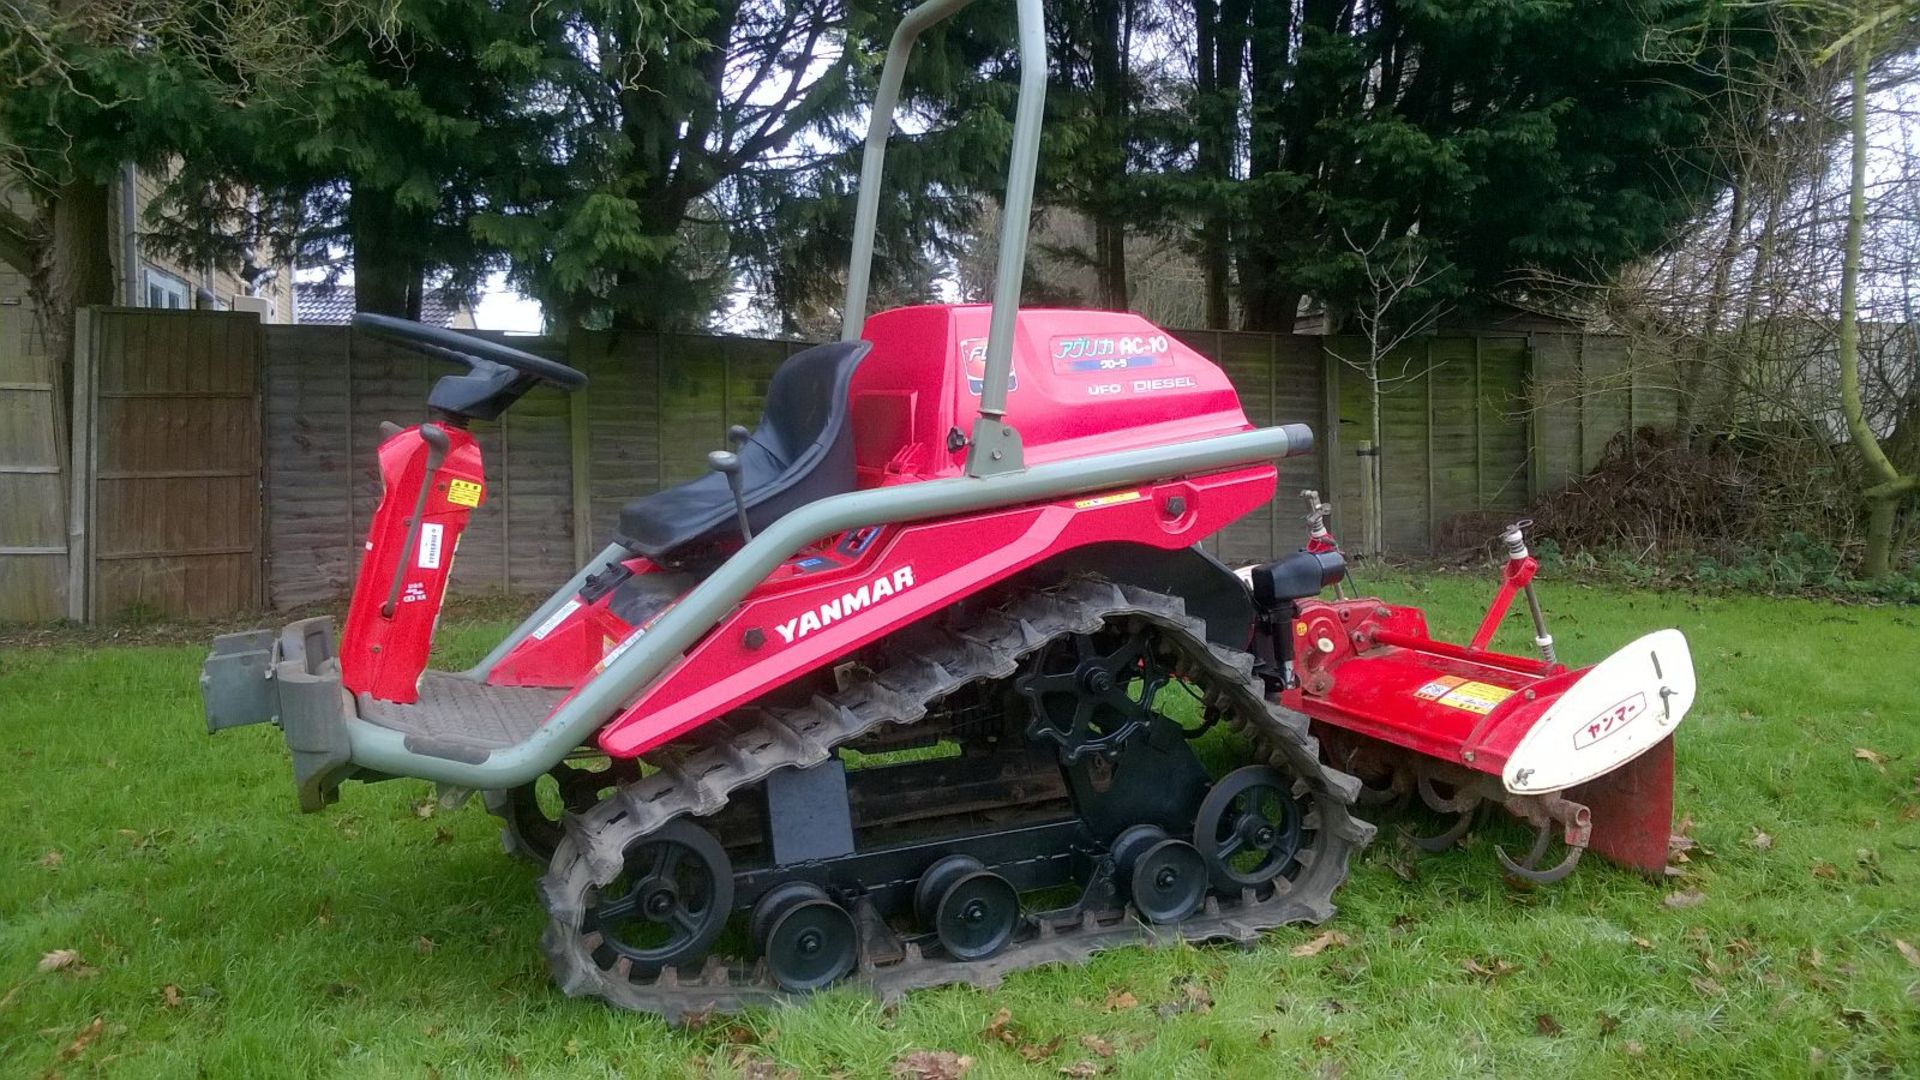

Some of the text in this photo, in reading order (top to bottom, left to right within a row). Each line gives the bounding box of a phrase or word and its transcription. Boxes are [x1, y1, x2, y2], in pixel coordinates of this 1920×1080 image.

[1055, 335, 1168, 358] アグリカ AC-10
[1088, 376, 1196, 396] UFO DIESEL
[774, 565, 915, 644] YANMAR
[1587, 704, 1636, 739] ヤンマー
